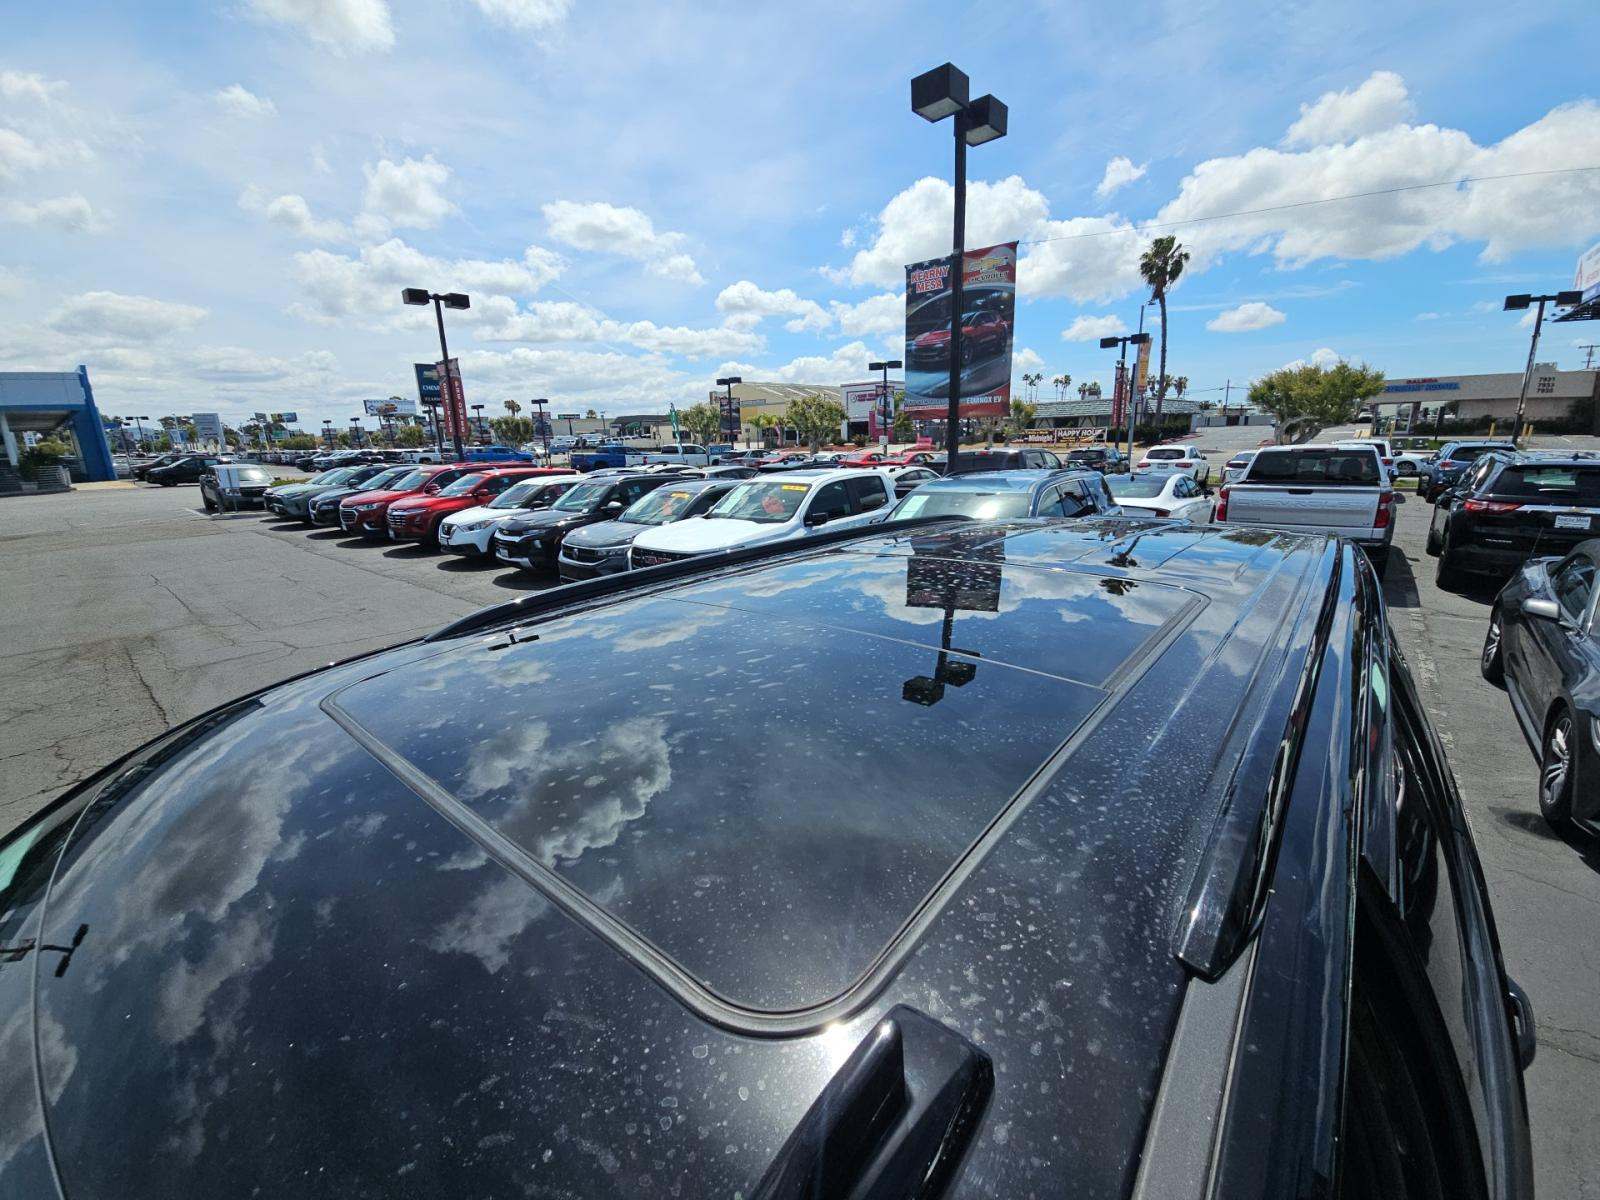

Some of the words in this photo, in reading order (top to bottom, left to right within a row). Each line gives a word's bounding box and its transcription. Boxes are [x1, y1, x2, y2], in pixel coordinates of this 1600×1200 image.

[911, 265, 950, 283] KEARNY
[916, 278, 944, 293] MESA
[1057, 429, 1080, 437] HAPPY
